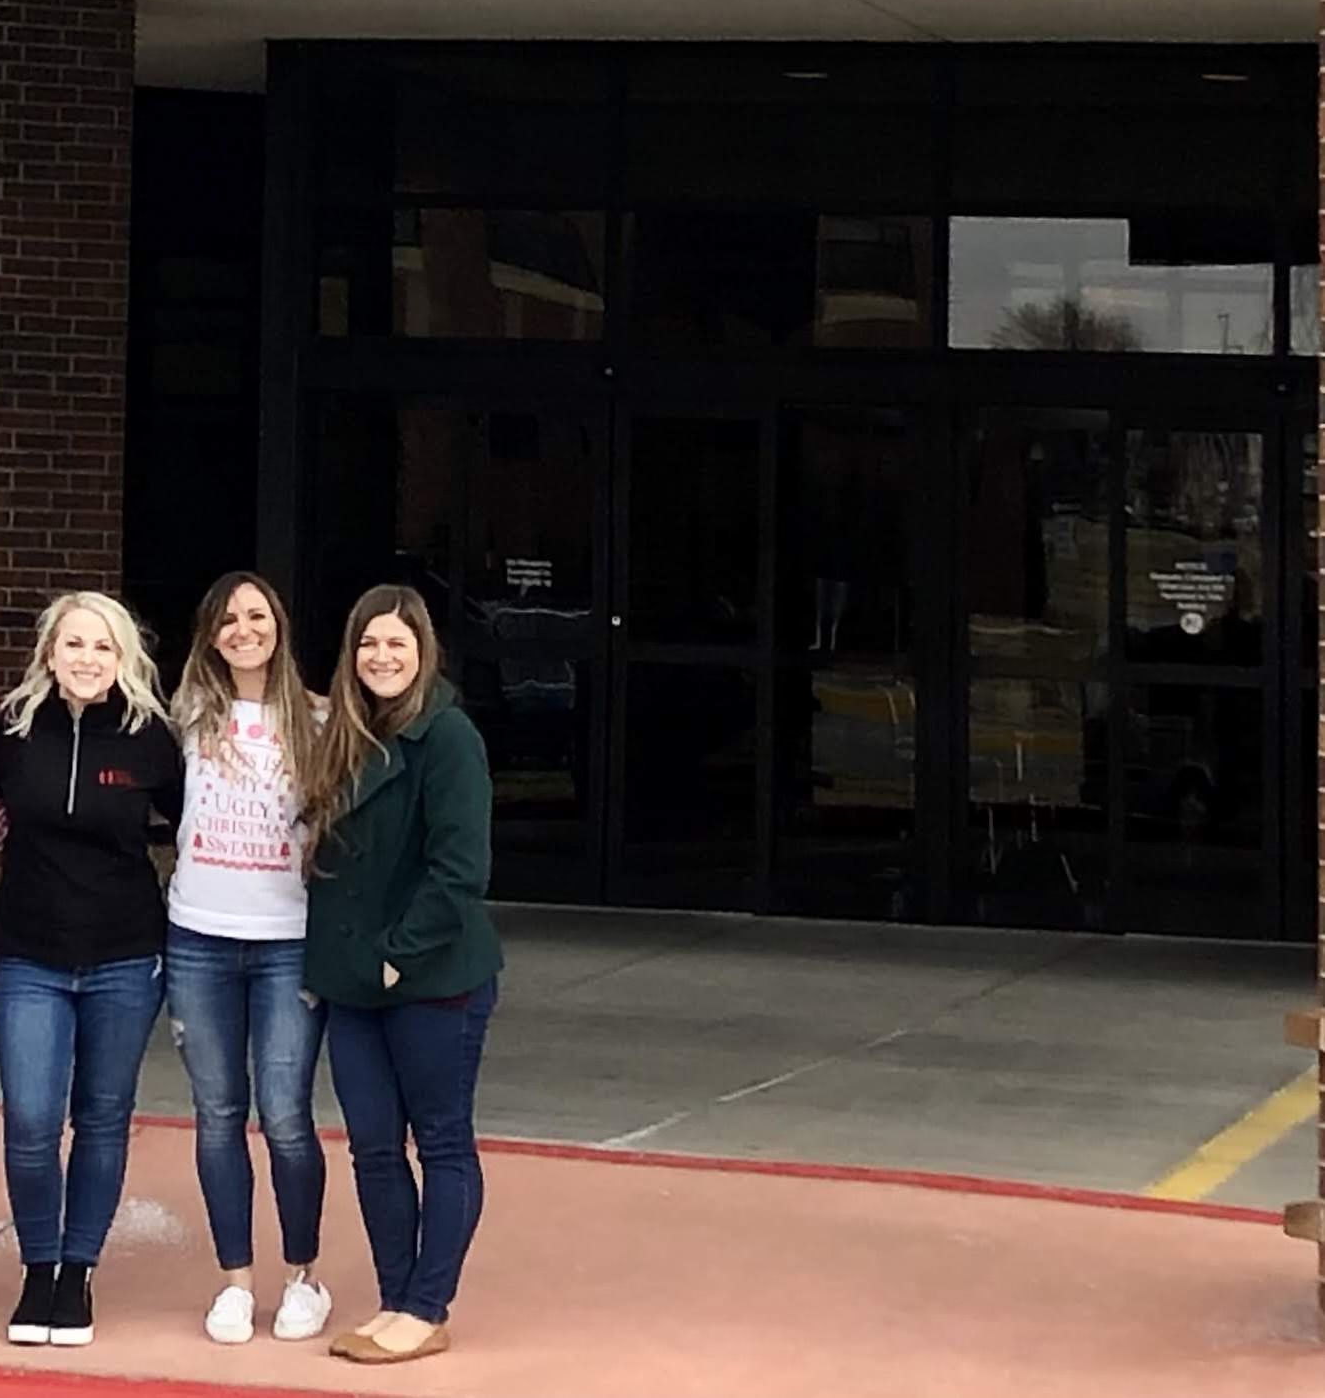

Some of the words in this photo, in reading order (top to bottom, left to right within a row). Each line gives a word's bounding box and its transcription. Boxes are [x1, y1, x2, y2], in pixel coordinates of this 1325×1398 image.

[215, 792, 269, 818] UGLY
[195, 816, 294, 841] CHRISTMAS
[206, 835, 277, 859] SWEATER
